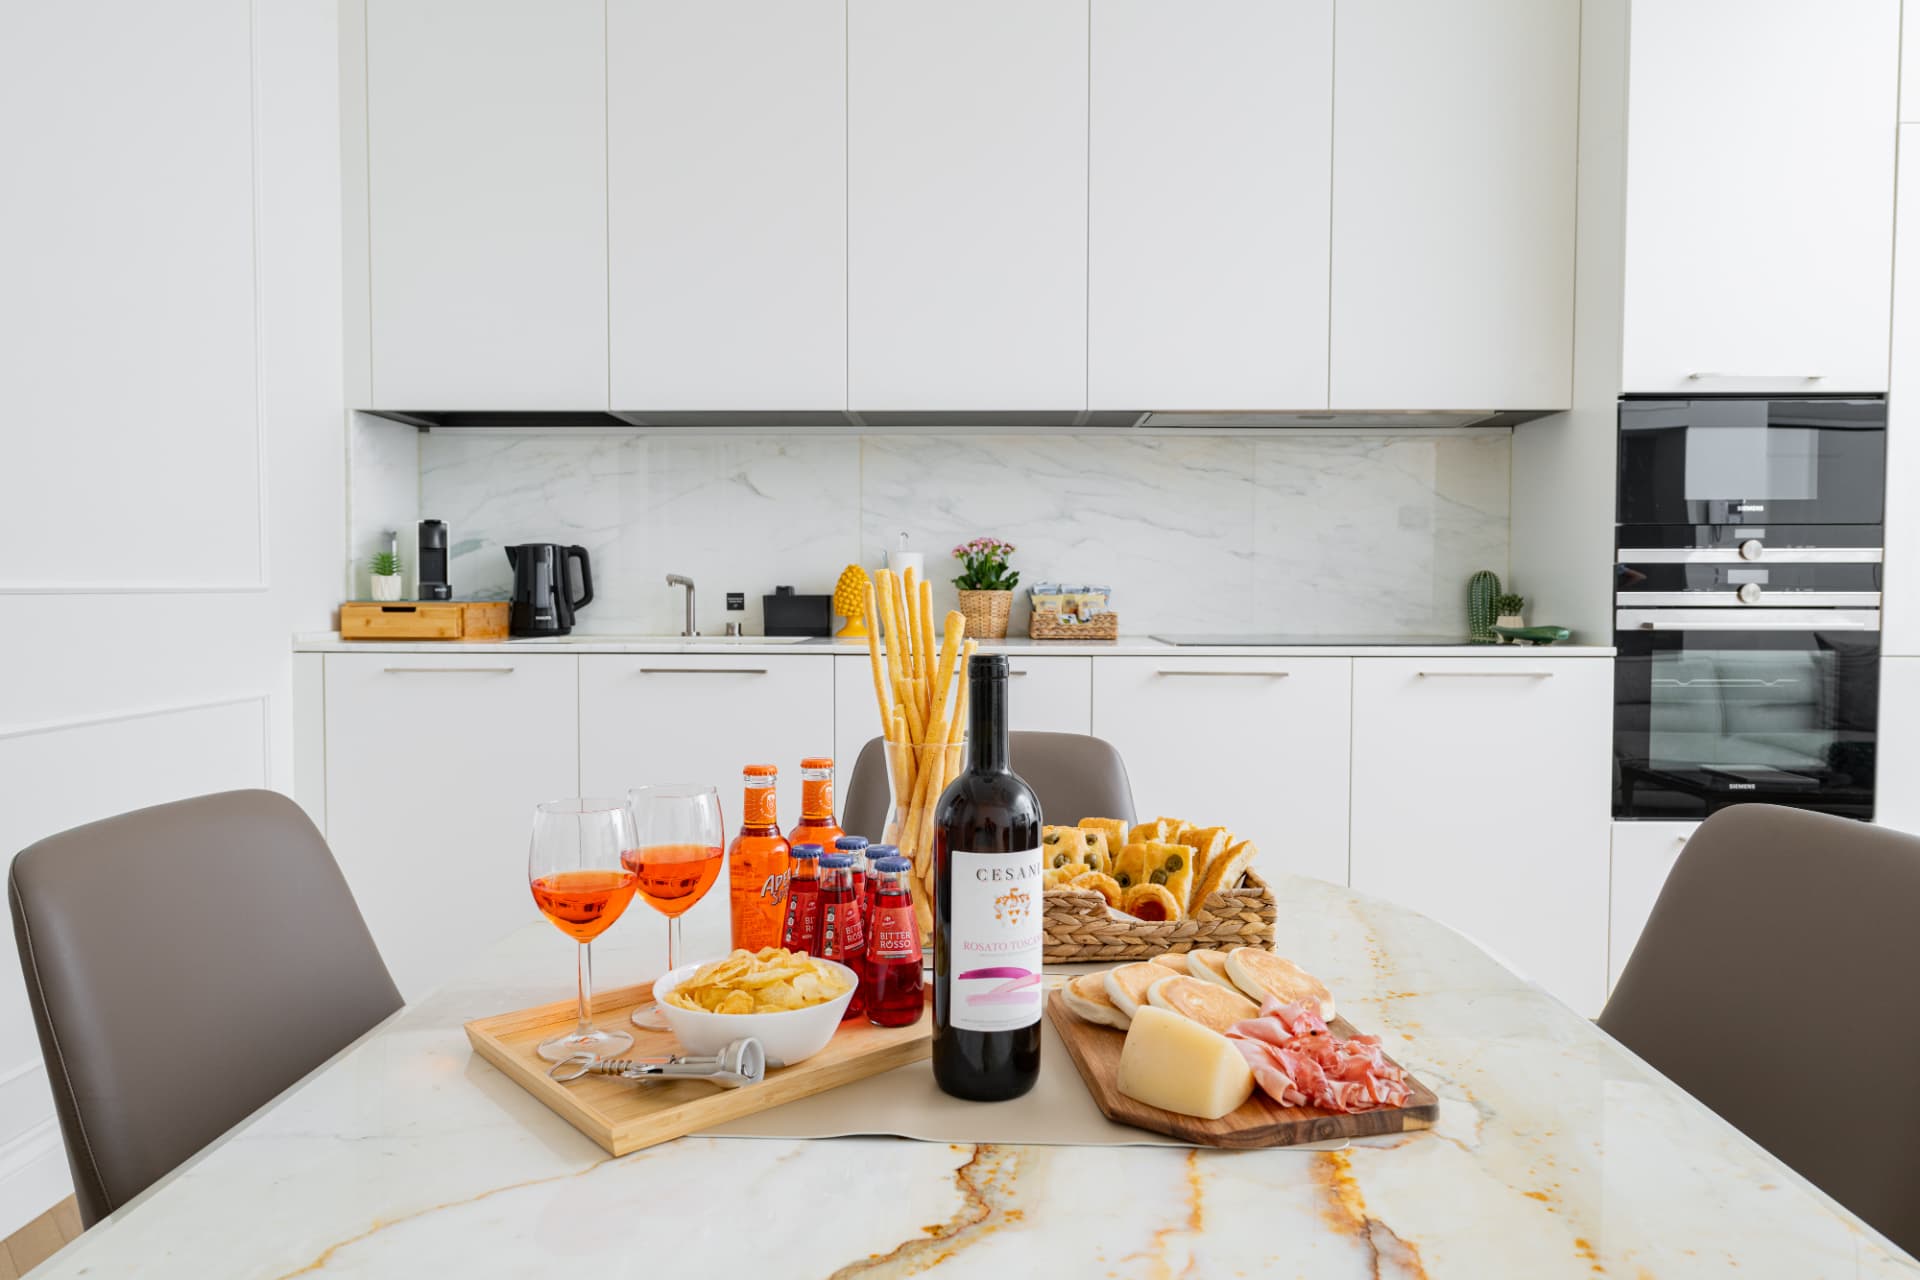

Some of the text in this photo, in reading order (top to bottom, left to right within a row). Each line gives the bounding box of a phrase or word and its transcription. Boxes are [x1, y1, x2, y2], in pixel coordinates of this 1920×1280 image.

[880, 931, 911, 940] BITTER
[880, 940, 911, 949] ROSSO
[963, 940, 1008, 952] ROSATO
